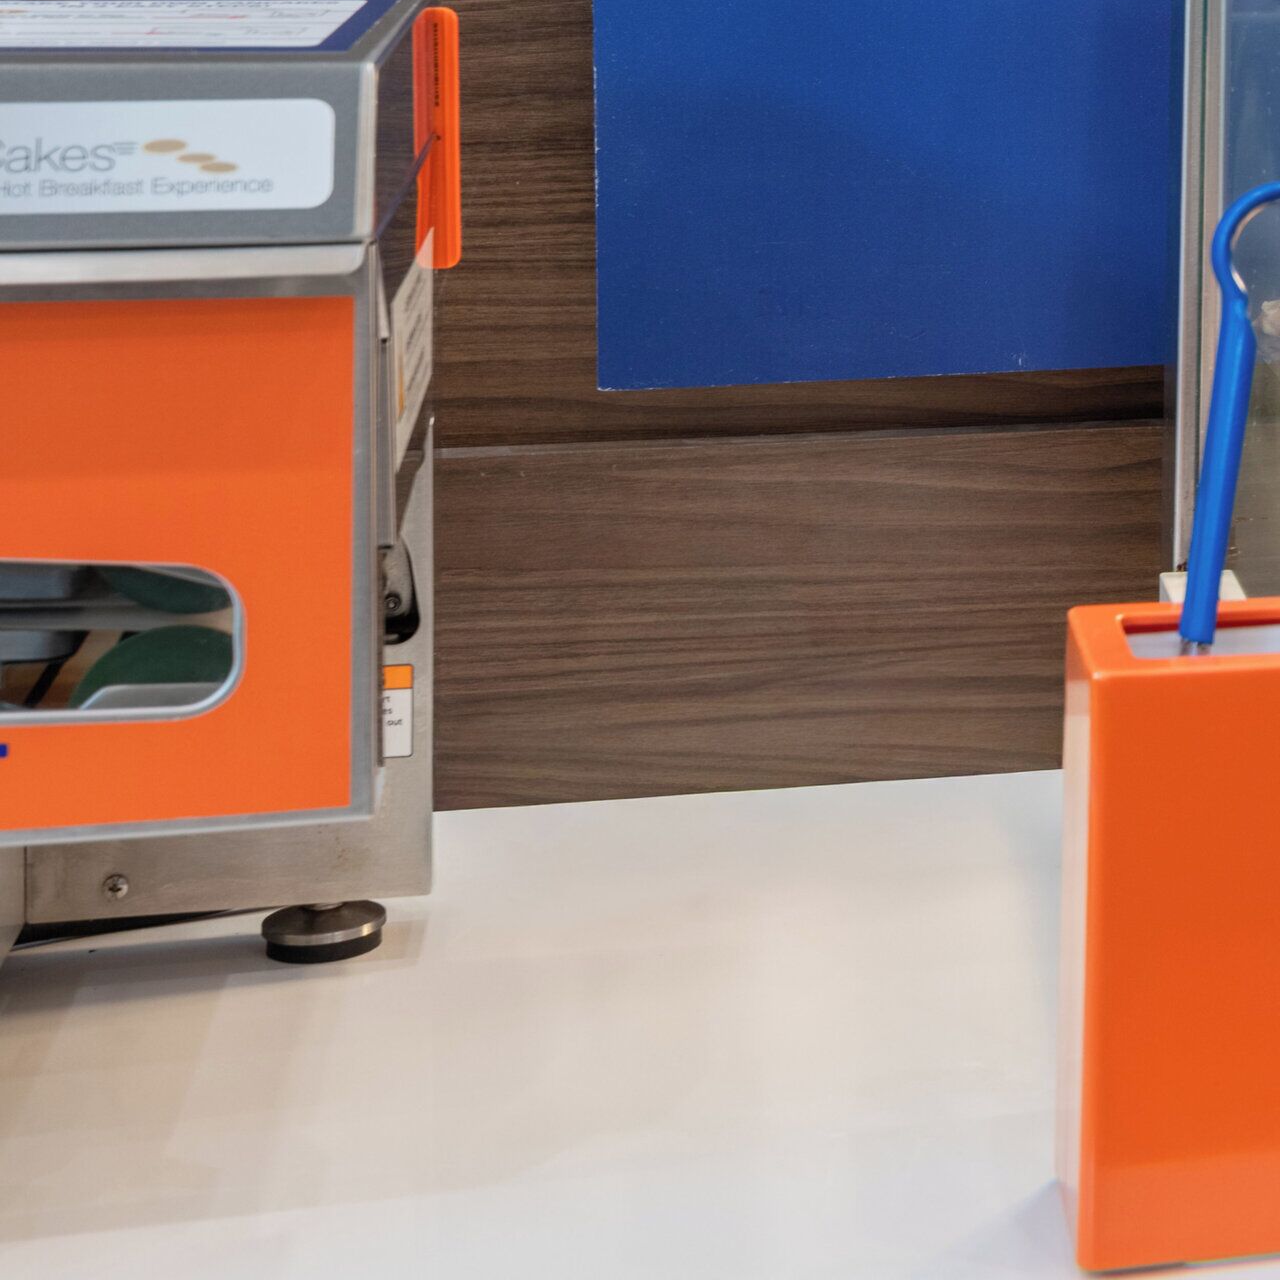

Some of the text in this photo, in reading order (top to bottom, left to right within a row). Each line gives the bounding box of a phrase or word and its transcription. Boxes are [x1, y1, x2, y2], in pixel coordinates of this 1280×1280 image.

[0, 136, 117, 174] akes
[38, 178, 145, 198] Breakfast
[150, 176, 274, 199] Experience
